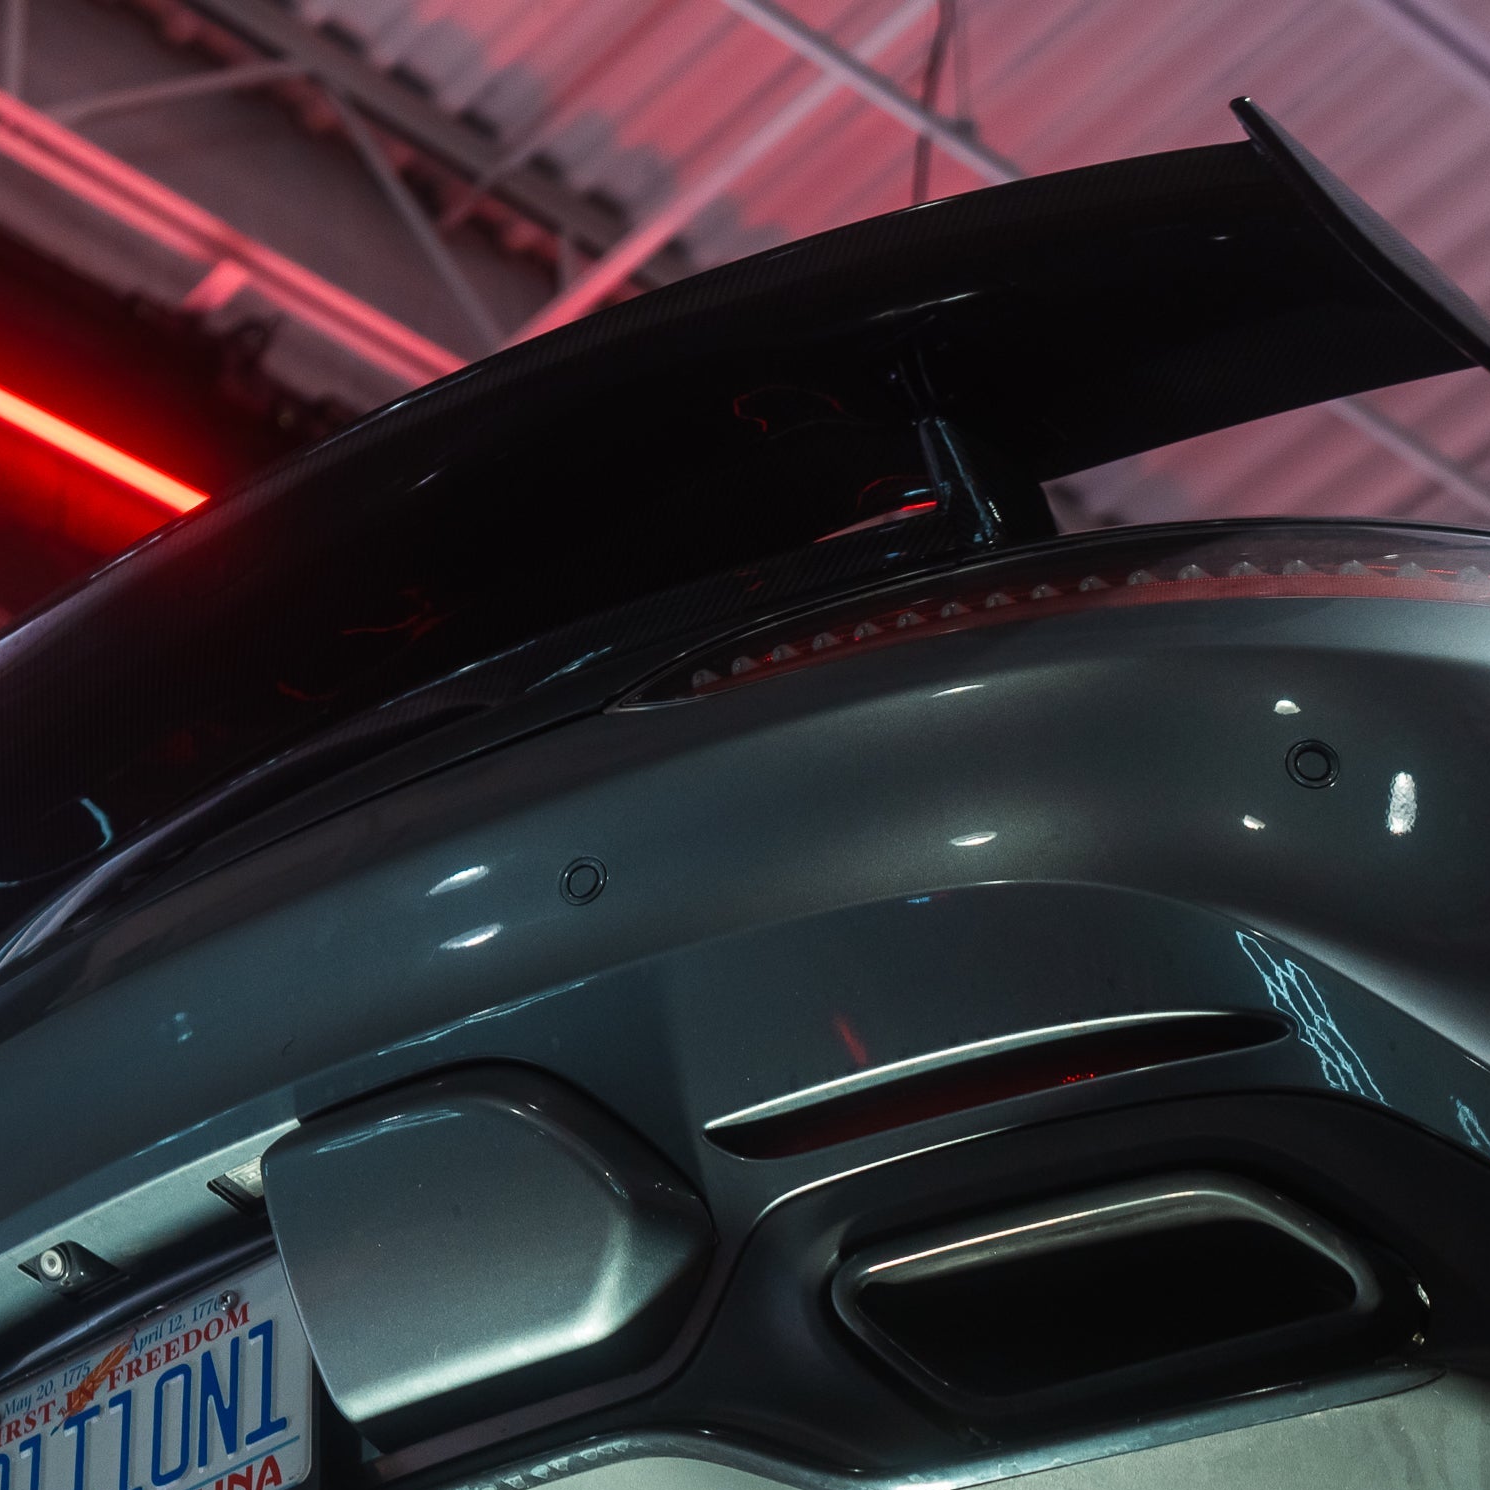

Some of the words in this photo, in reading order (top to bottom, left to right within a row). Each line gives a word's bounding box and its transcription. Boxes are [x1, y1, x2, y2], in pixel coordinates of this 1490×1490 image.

[106, 1302, 250, 1392] FREEDOM
[128, 1320, 167, 1355] April
[3, 1394, 32, 1419] May
[63, 1361, 90, 1388] 1775
